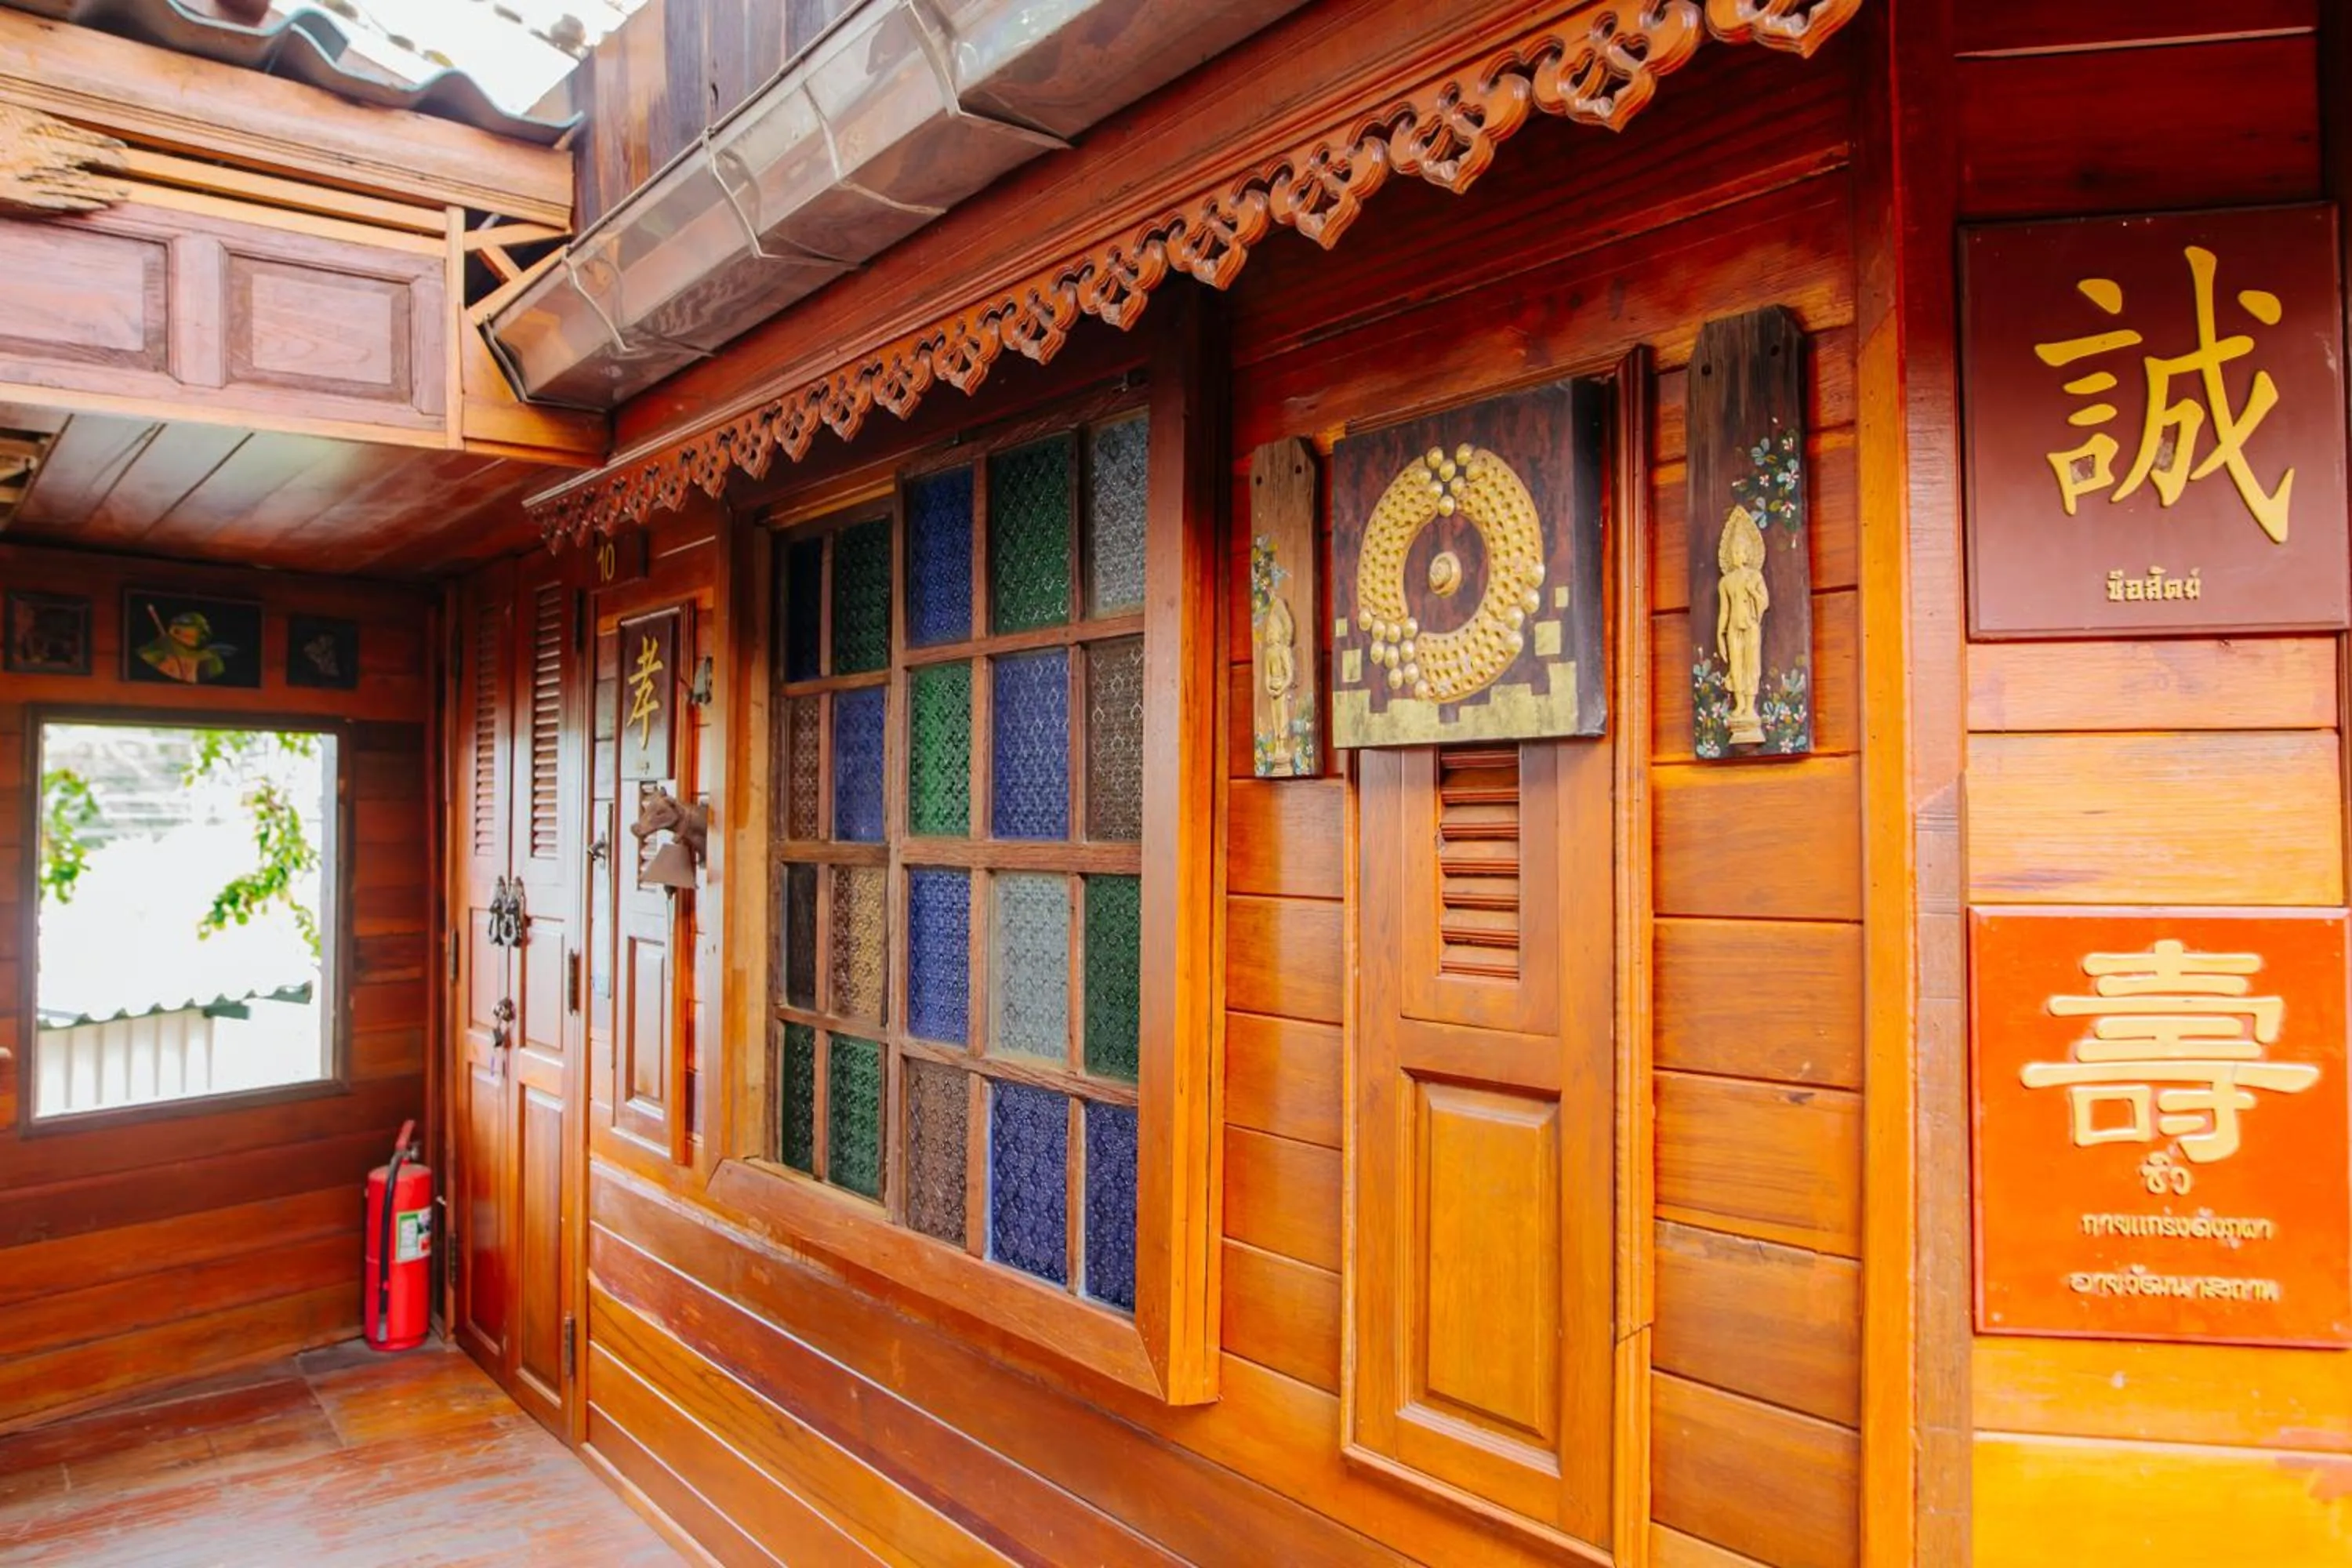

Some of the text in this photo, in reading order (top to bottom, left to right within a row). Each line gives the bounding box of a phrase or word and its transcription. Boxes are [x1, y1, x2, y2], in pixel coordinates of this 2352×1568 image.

[2034, 245, 2295, 544] 誠
[597, 543, 615, 582] 10
[2020, 939, 2320, 1163] 壽
